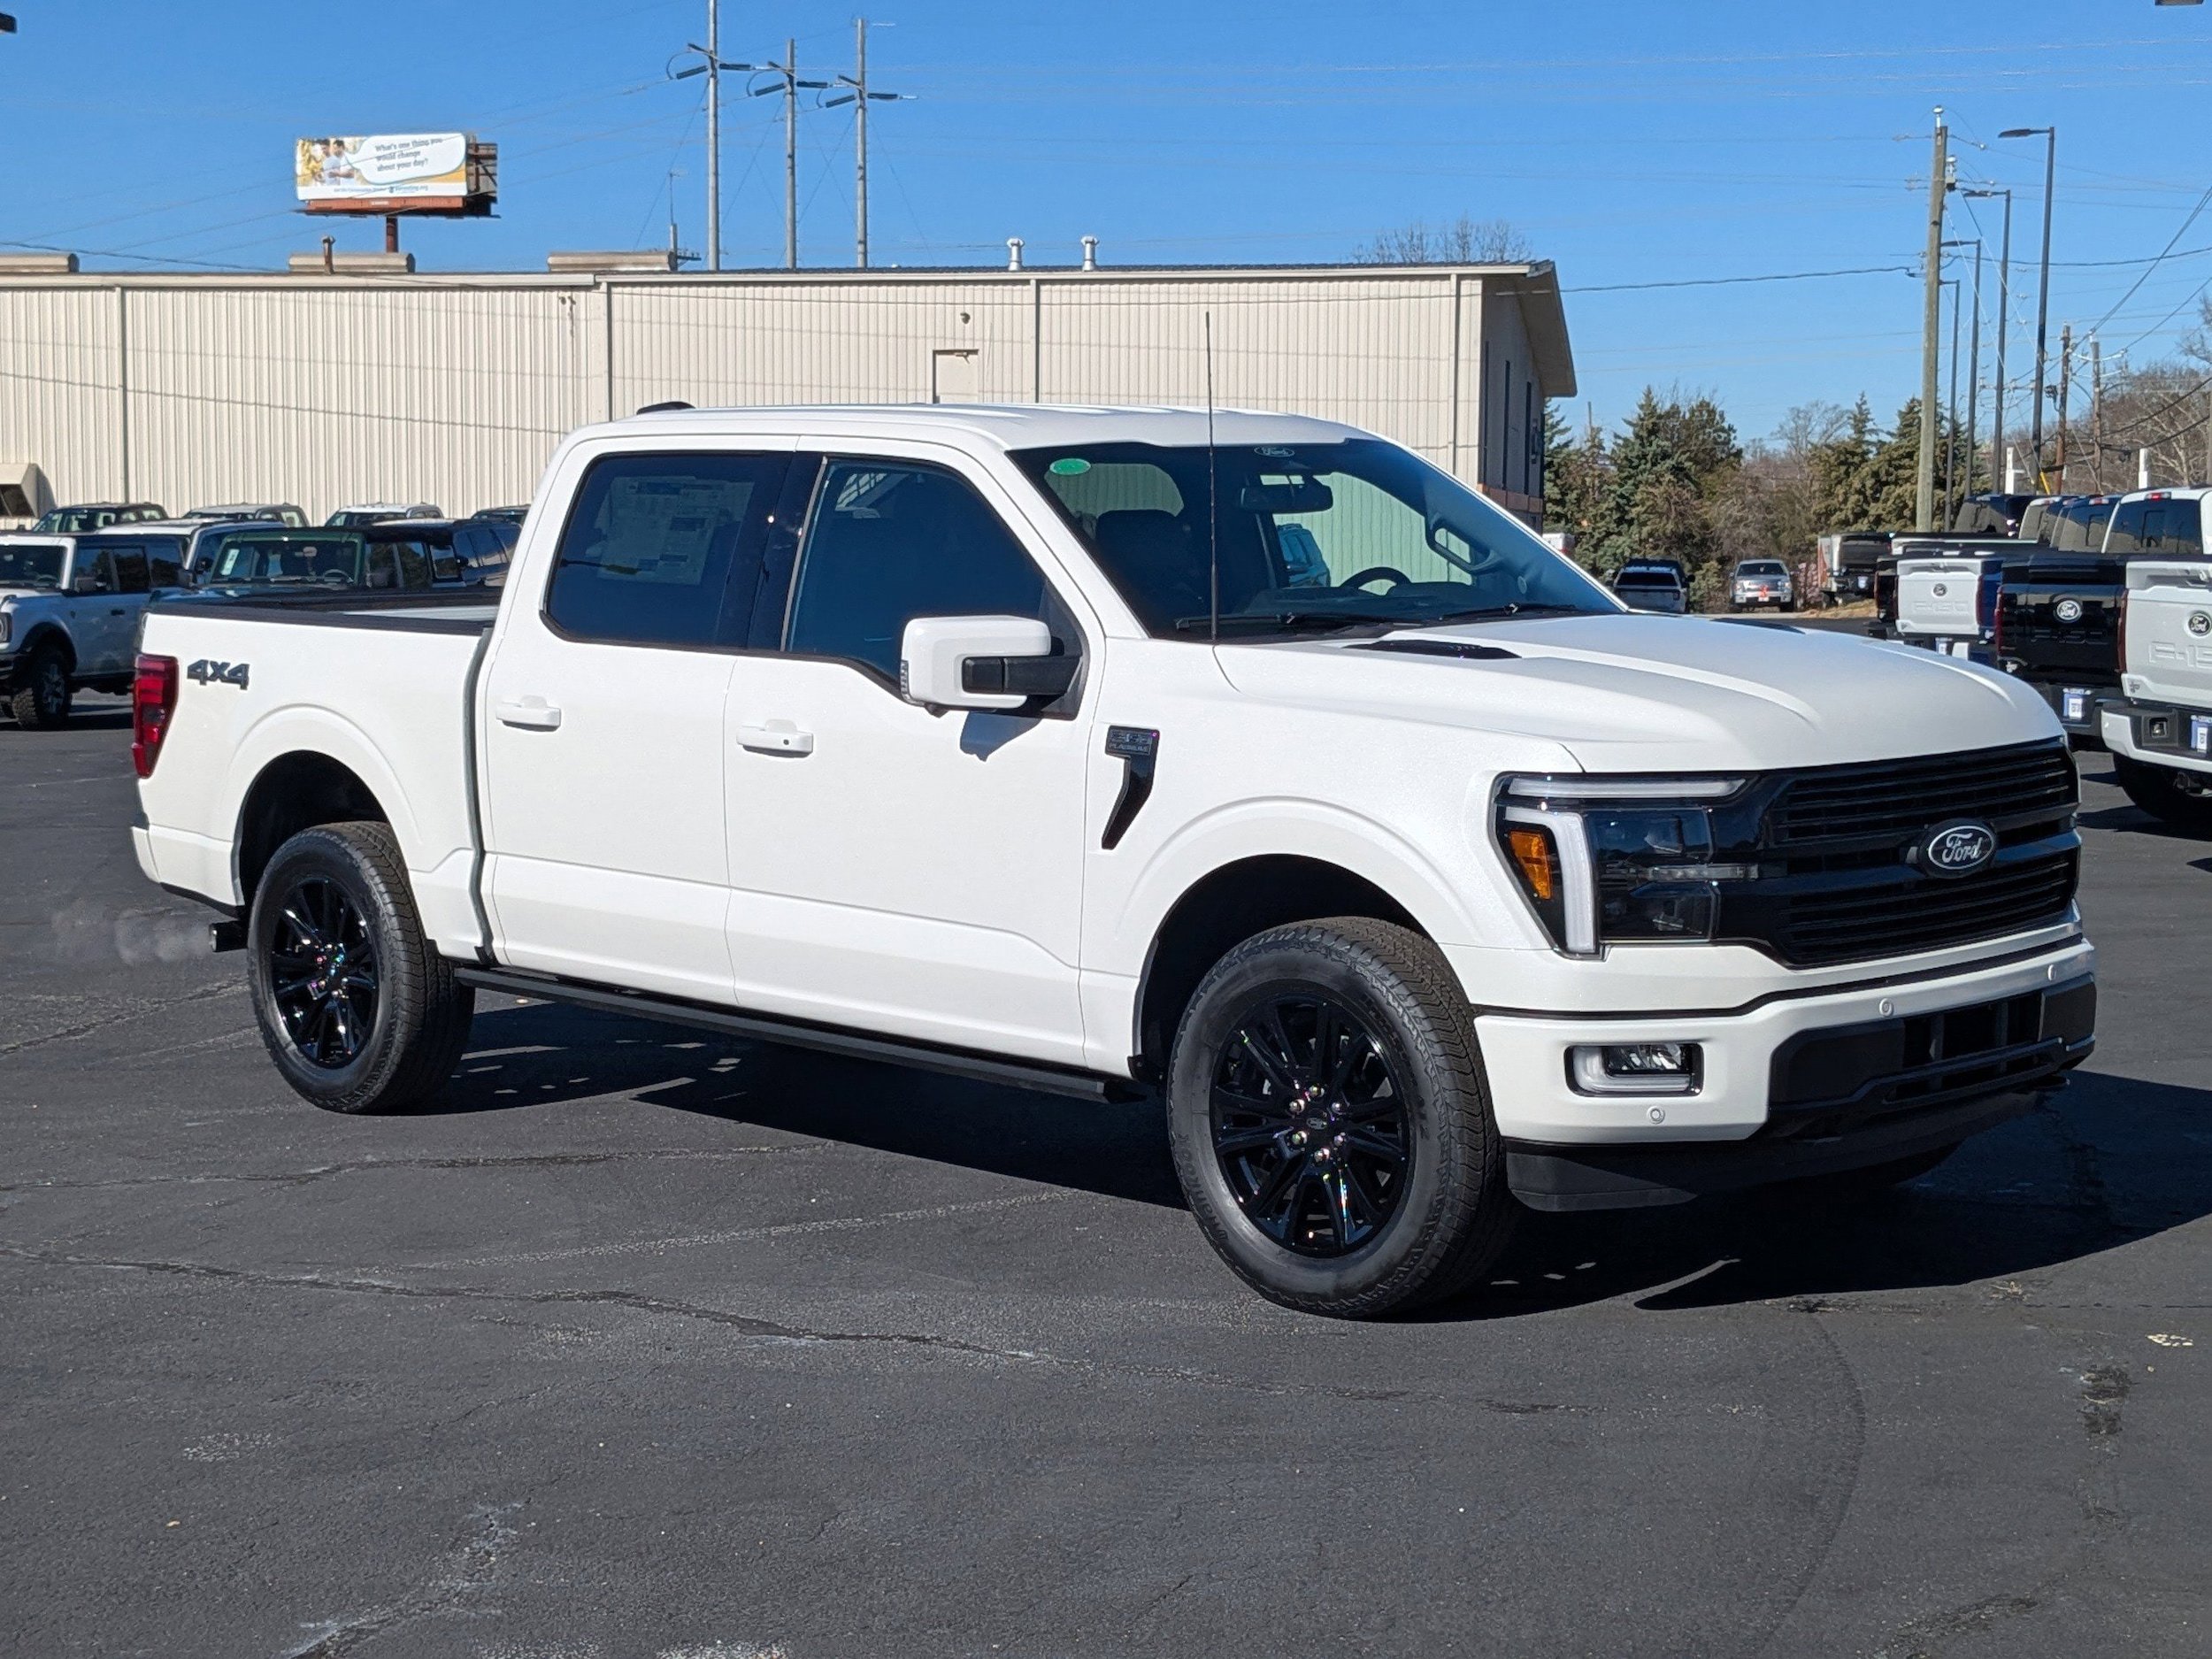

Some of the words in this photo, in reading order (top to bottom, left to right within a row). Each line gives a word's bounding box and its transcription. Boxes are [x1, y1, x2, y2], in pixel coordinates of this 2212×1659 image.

[375, 151, 396, 161] would
[397, 150, 420, 159] change
[396, 162, 411, 171] your
[2190, 616, 2208, 632] Ford
[1941, 832, 1984, 864] Ford
